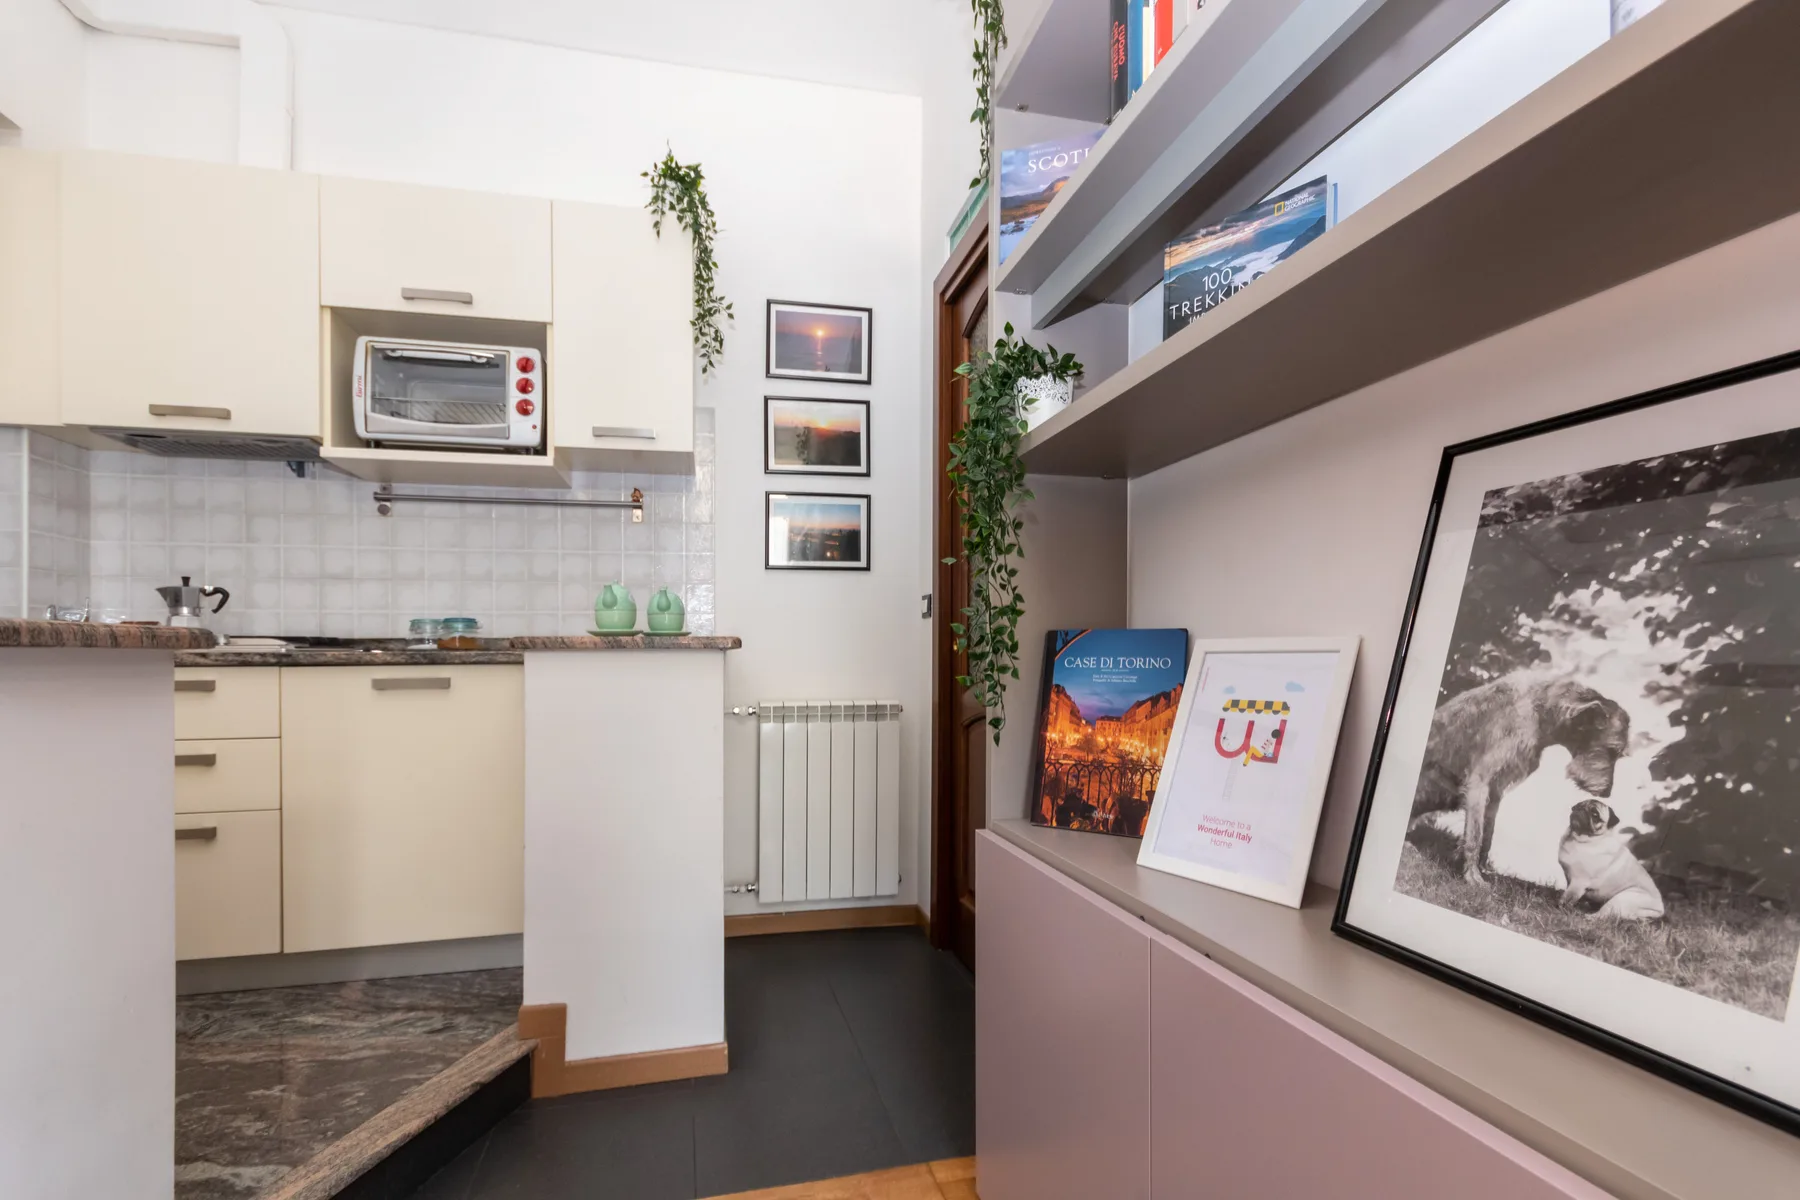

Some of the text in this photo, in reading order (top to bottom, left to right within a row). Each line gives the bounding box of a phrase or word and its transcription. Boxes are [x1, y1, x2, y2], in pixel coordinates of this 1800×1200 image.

[1202, 268, 1232, 291] 100
[1169, 274, 1264, 320] TREKKIN
[1064, 657, 1172, 669] CASE DI TORINO
[1202, 814, 1235, 828] Welcome
[1237, 821, 1245, 830] to
[1197, 823, 1253, 844] Wonderful Italy
[1210, 837, 1233, 849] Home
